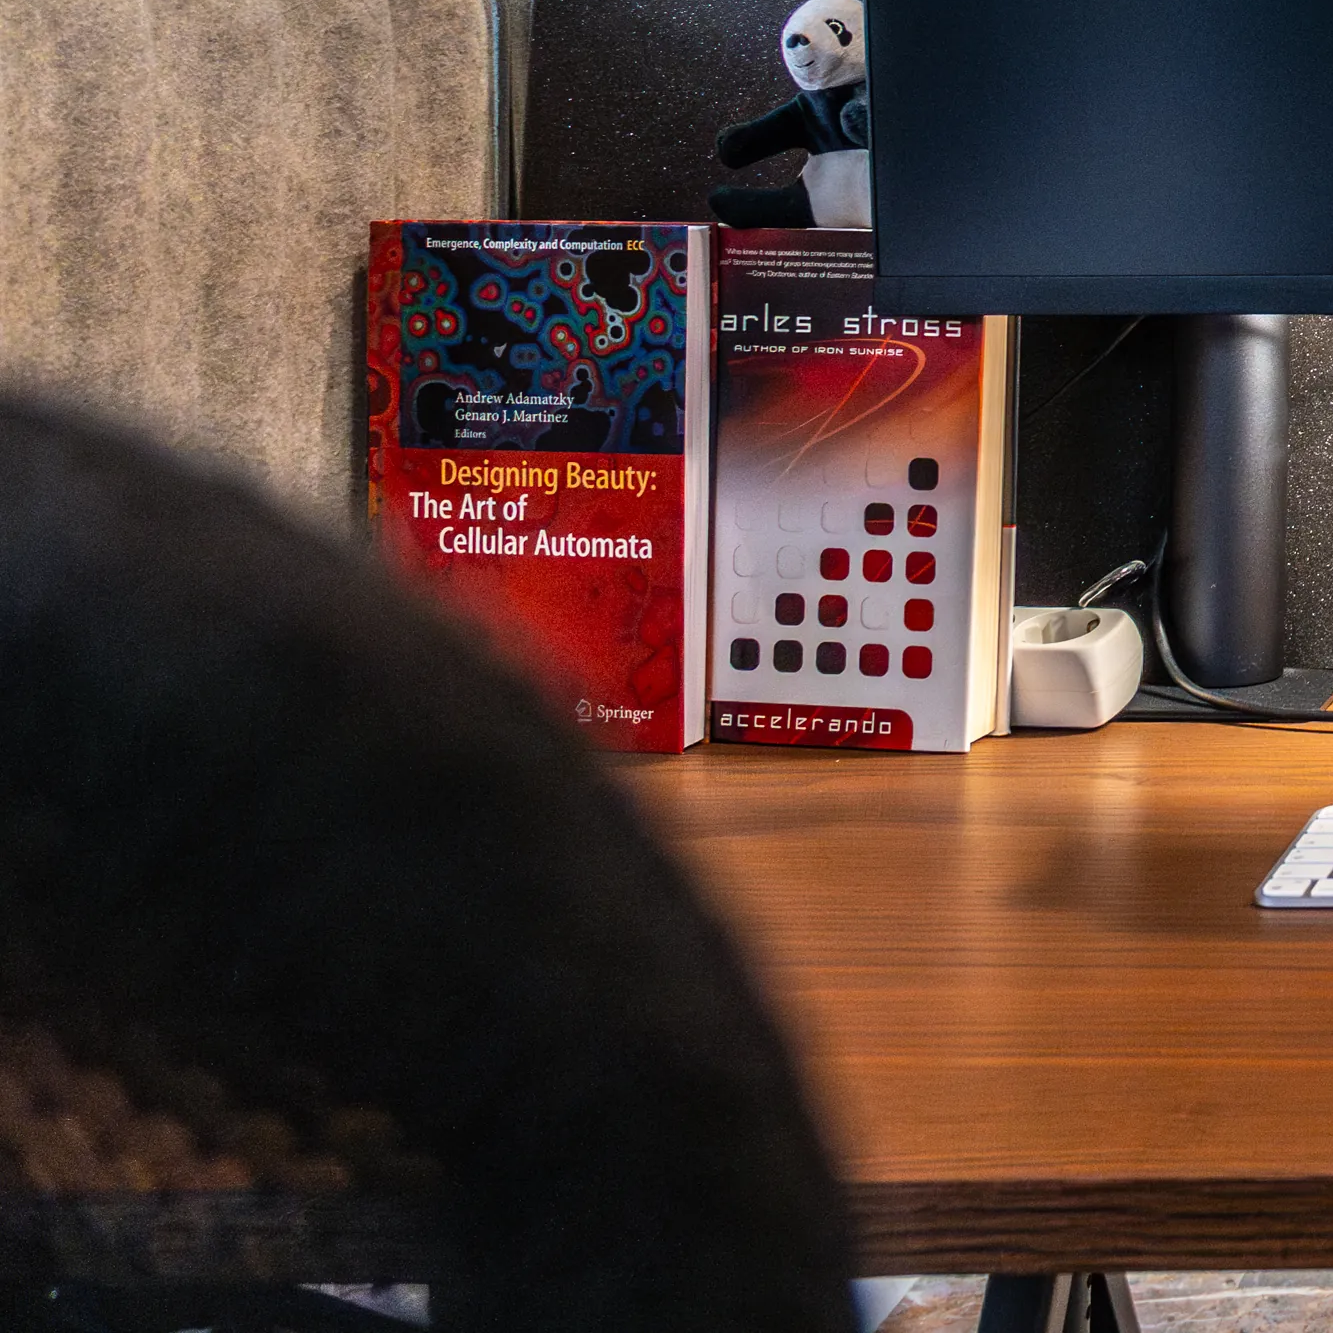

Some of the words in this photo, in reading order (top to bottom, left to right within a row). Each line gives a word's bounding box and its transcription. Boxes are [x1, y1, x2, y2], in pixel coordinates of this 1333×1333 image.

[426, 237, 482, 251] Emergence,
[483, 238, 538, 252] Complexity
[539, 239, 558, 250] and
[559, 239, 623, 252] Computation
[626, 240, 645, 251] ECC
[719, 302, 812, 334] arles
[843, 305, 962, 338] stross
[734, 344, 786, 353] AUTHOR
[791, 346, 809, 354] OF
[814, 346, 844, 355] IRON
[849, 347, 904, 356] SUNRISE
[455, 391, 503, 404] Andrew
[505, 392, 575, 409] Adamatzky
[455, 408, 499, 421] Genaro
[501, 409, 511, 424] J.
[513, 410, 569, 423] Martinez
[454, 428, 487, 439] Editors
[441, 458, 559, 495] Designing
[566, 461, 657, 497] Beauty:
[409, 491, 452, 519] The
[459, 493, 497, 521] Art
[502, 494, 529, 521] of
[439, 526, 528, 555] Cellular
[533, 529, 653, 559] Automata
[596, 704, 655, 724] Springer
[720, 707, 892, 735] accelerando
